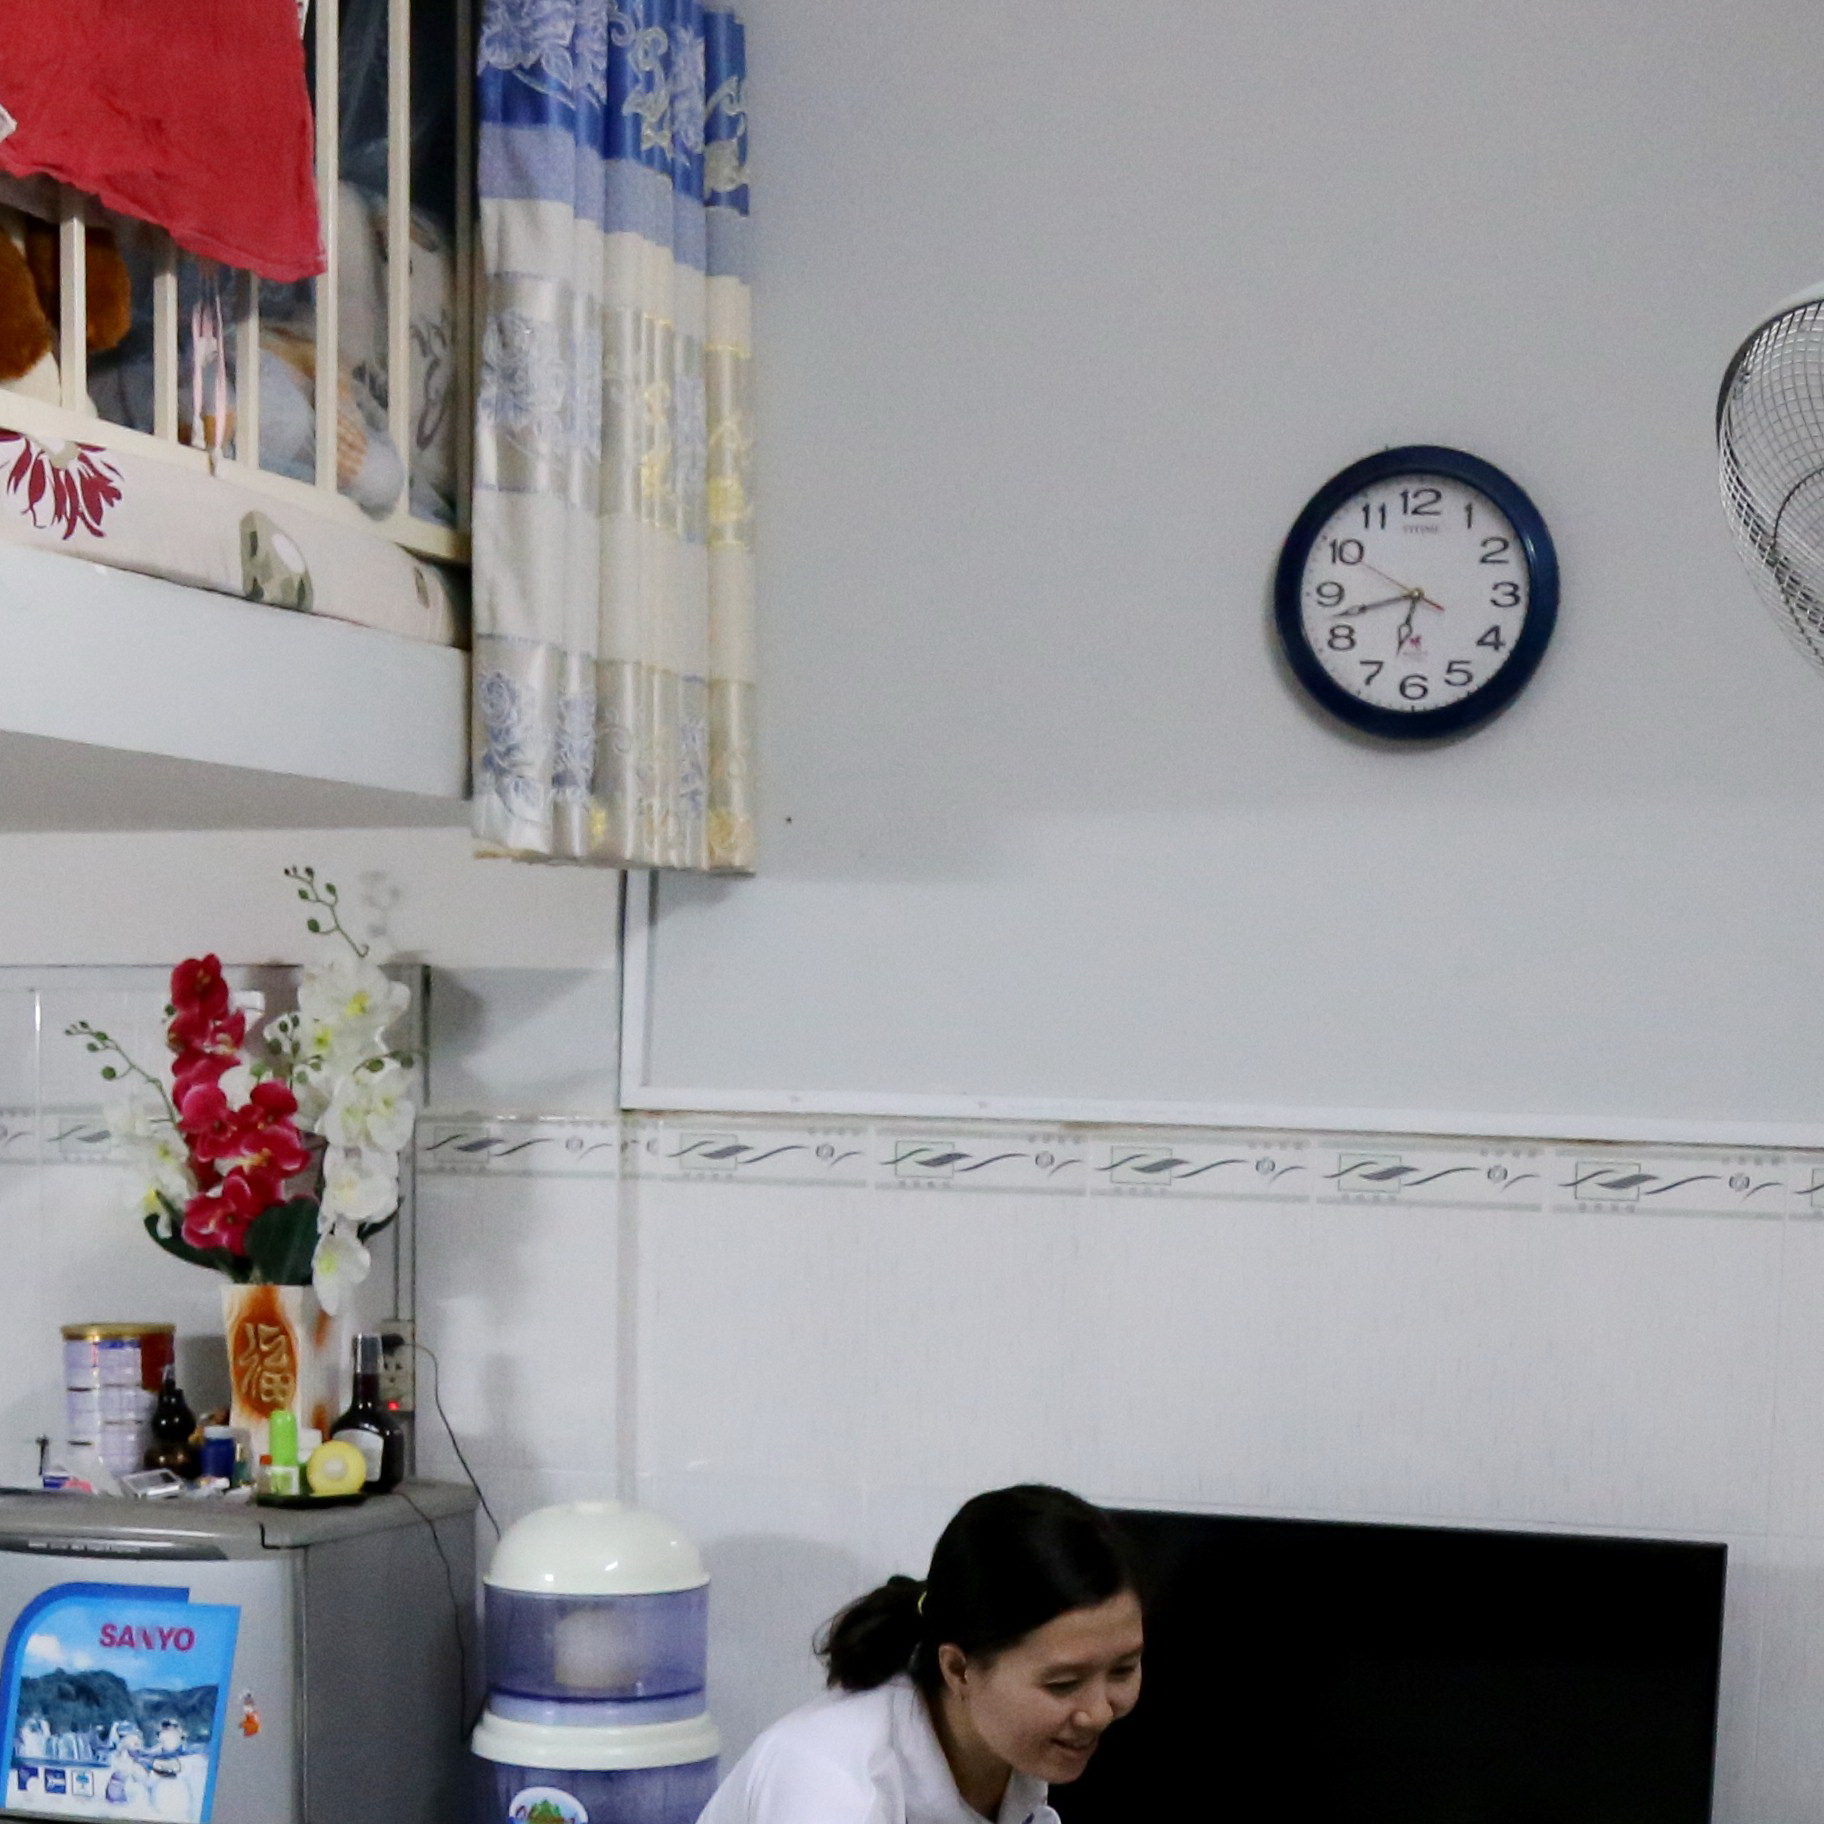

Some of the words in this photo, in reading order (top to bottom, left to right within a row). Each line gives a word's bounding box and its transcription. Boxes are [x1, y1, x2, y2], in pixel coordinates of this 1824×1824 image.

[1400, 488, 1443, 516] 12
[1362, 503, 1387, 530] 11
[1464, 503, 1474, 530] 1
[1329, 538, 1365, 565] 10
[1480, 537, 1510, 564] 2
[1316, 581, 1346, 607] 9
[1490, 581, 1522, 608] 3
[1328, 624, 1357, 651] 8
[1476, 625, 1506, 651] 4
[1360, 660, 1384, 686] 7
[1444, 660, 1474, 687] 5
[1399, 674, 1429, 701] 6
[99, 1623, 195, 1652] SANYO
